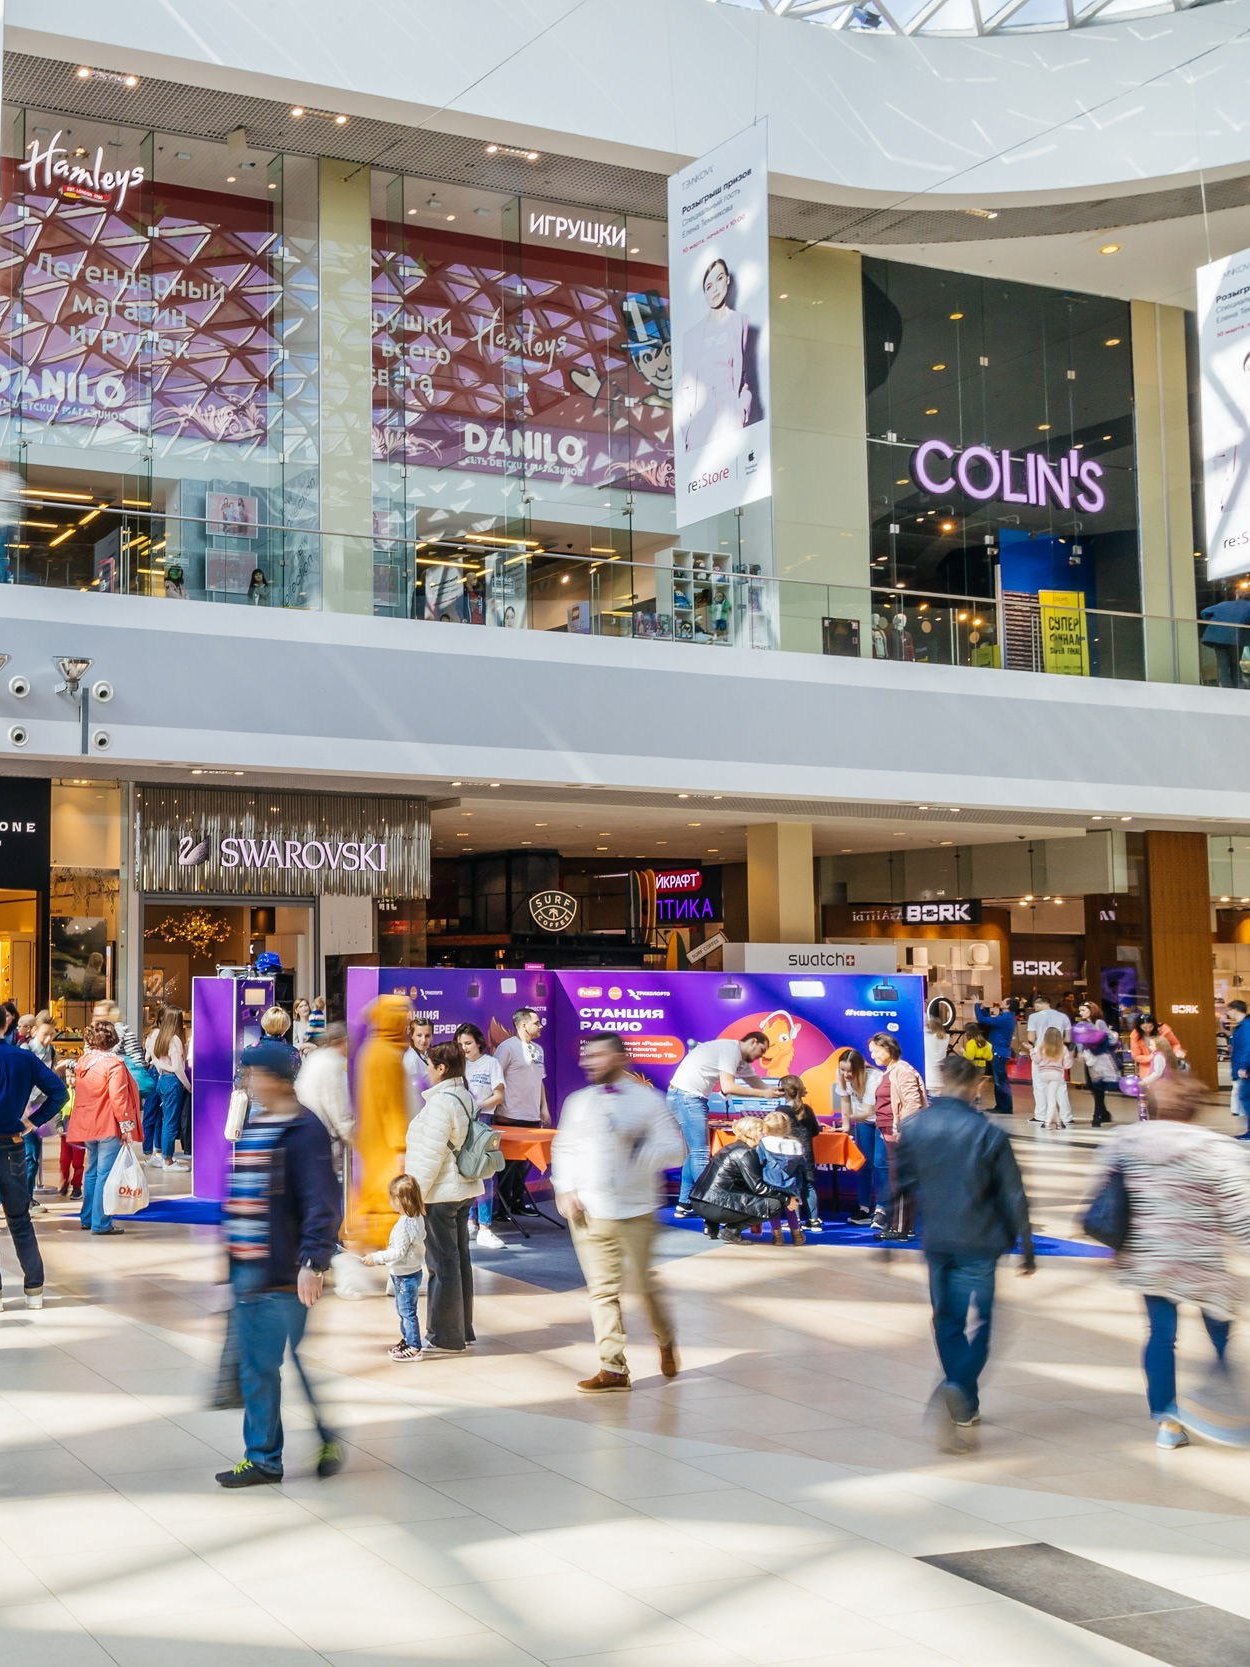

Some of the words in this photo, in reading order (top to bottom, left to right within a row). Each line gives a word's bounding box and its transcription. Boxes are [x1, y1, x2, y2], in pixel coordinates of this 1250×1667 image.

[18, 130, 145, 212] Hamleys
[682, 186, 722, 215] Розыгрыш
[530, 213, 626, 248] ИГРУШКИ
[32, 252, 226, 302] Легендарный
[72, 294, 188, 328] магазин
[464, 423, 584, 465] DANILO
[688, 468, 730, 494] re:Store
[915, 439, 1105, 513] COLIN'S
[1048, 616, 1079, 632] СУПЕР
[220, 837, 388, 872] SWAROVSKI
[535, 895, 572, 908] SURF
[537, 914, 570, 929] COFFEE
[906, 904, 972, 922] BORK
[788, 952, 845, 966] swatch
[1012, 960, 1064, 976] BORK
[580, 1008, 664, 1019] СТАНЦИЯ
[1172, 1004, 1199, 1014] BORK
[580, 1021, 642, 1032] РАДИО
